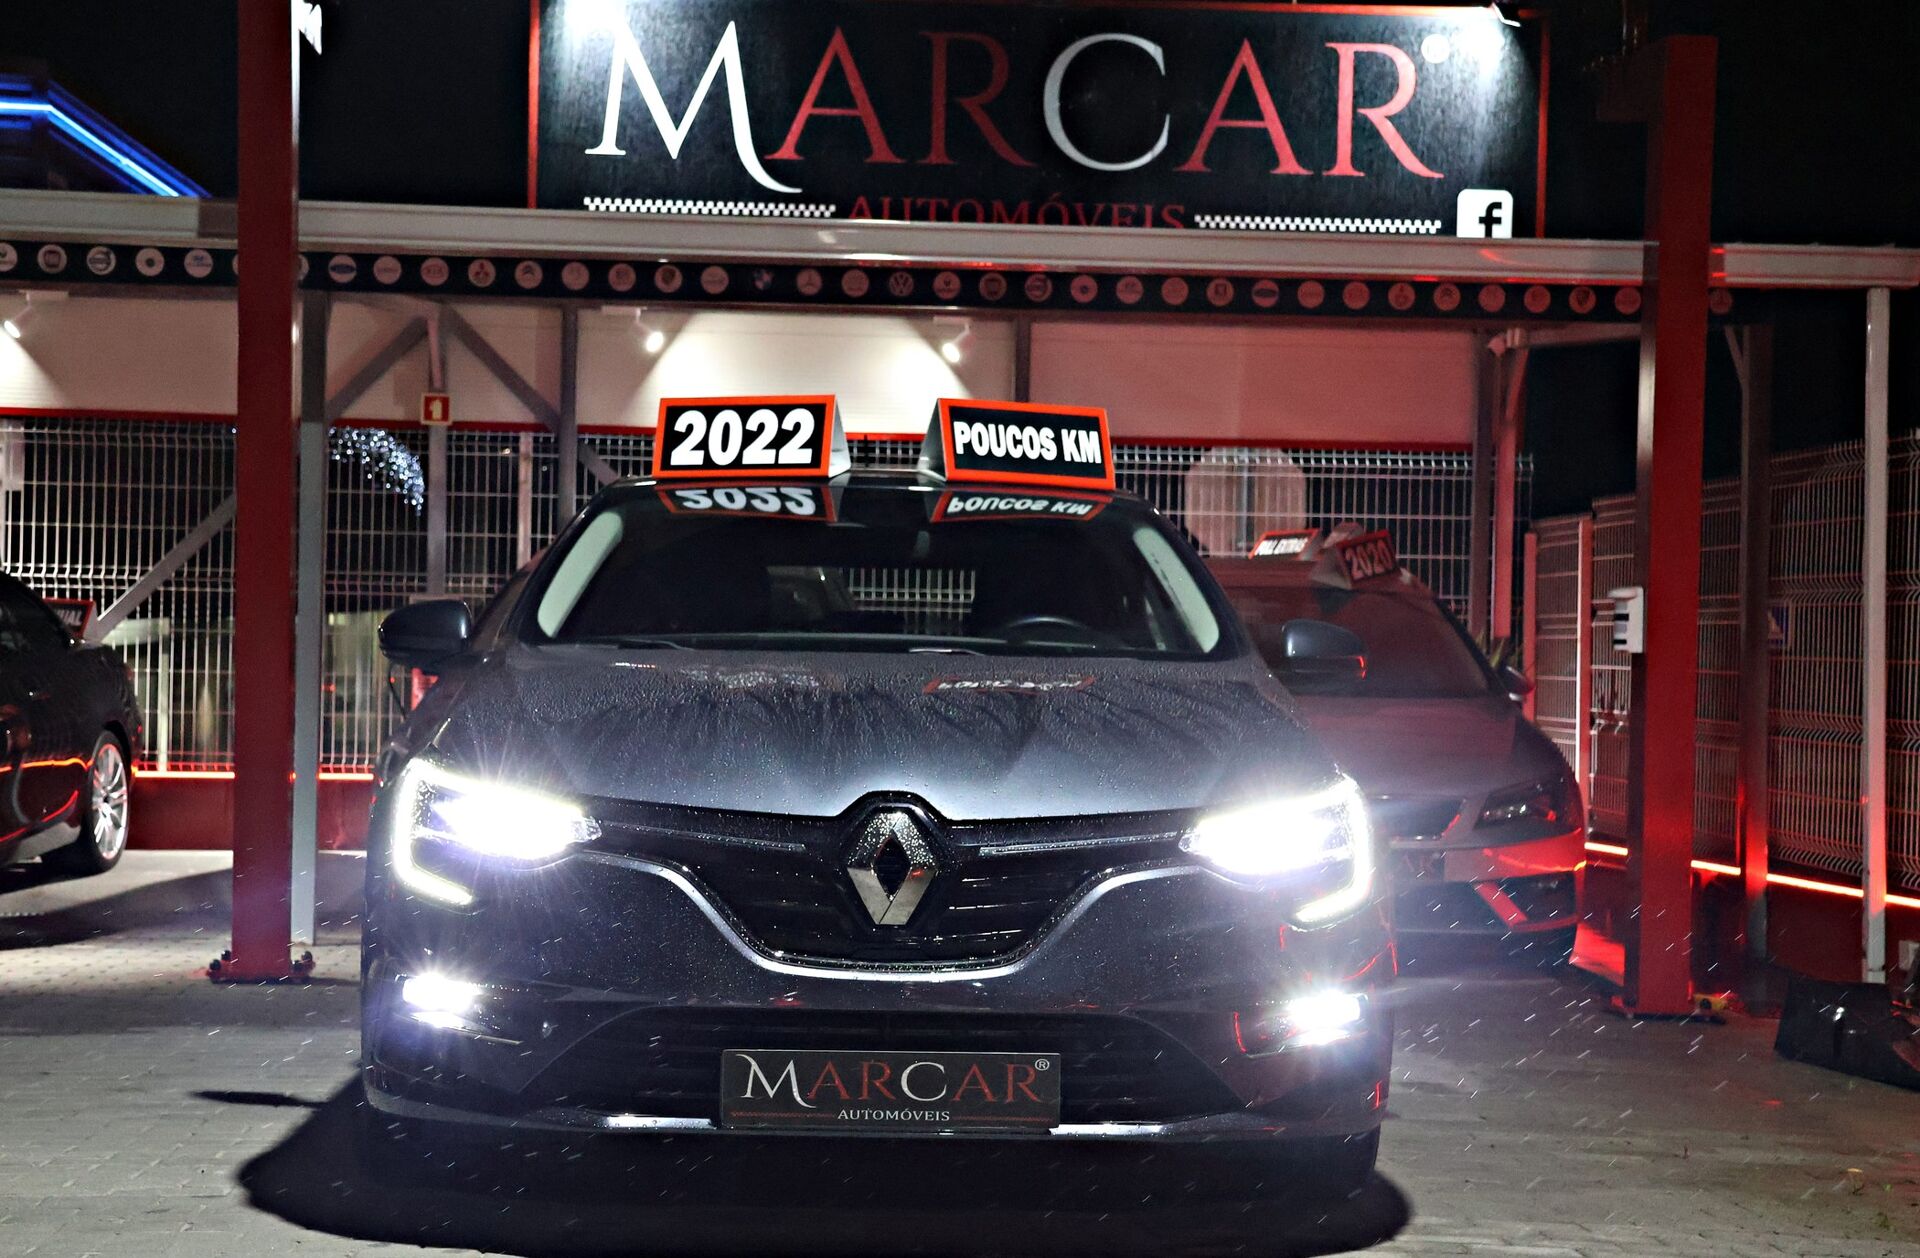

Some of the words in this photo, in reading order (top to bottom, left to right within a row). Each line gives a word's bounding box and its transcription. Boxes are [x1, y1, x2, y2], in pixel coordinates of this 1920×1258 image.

[584, 20, 1444, 193] MARCAR
[670, 408, 815, 465] 2022
[953, 421, 1058, 461] POUCOS
[1061, 428, 1102, 464] KM
[1345, 539, 1393, 581] 2020
[837, 1108, 950, 1122] AUTOMÓVEIS
